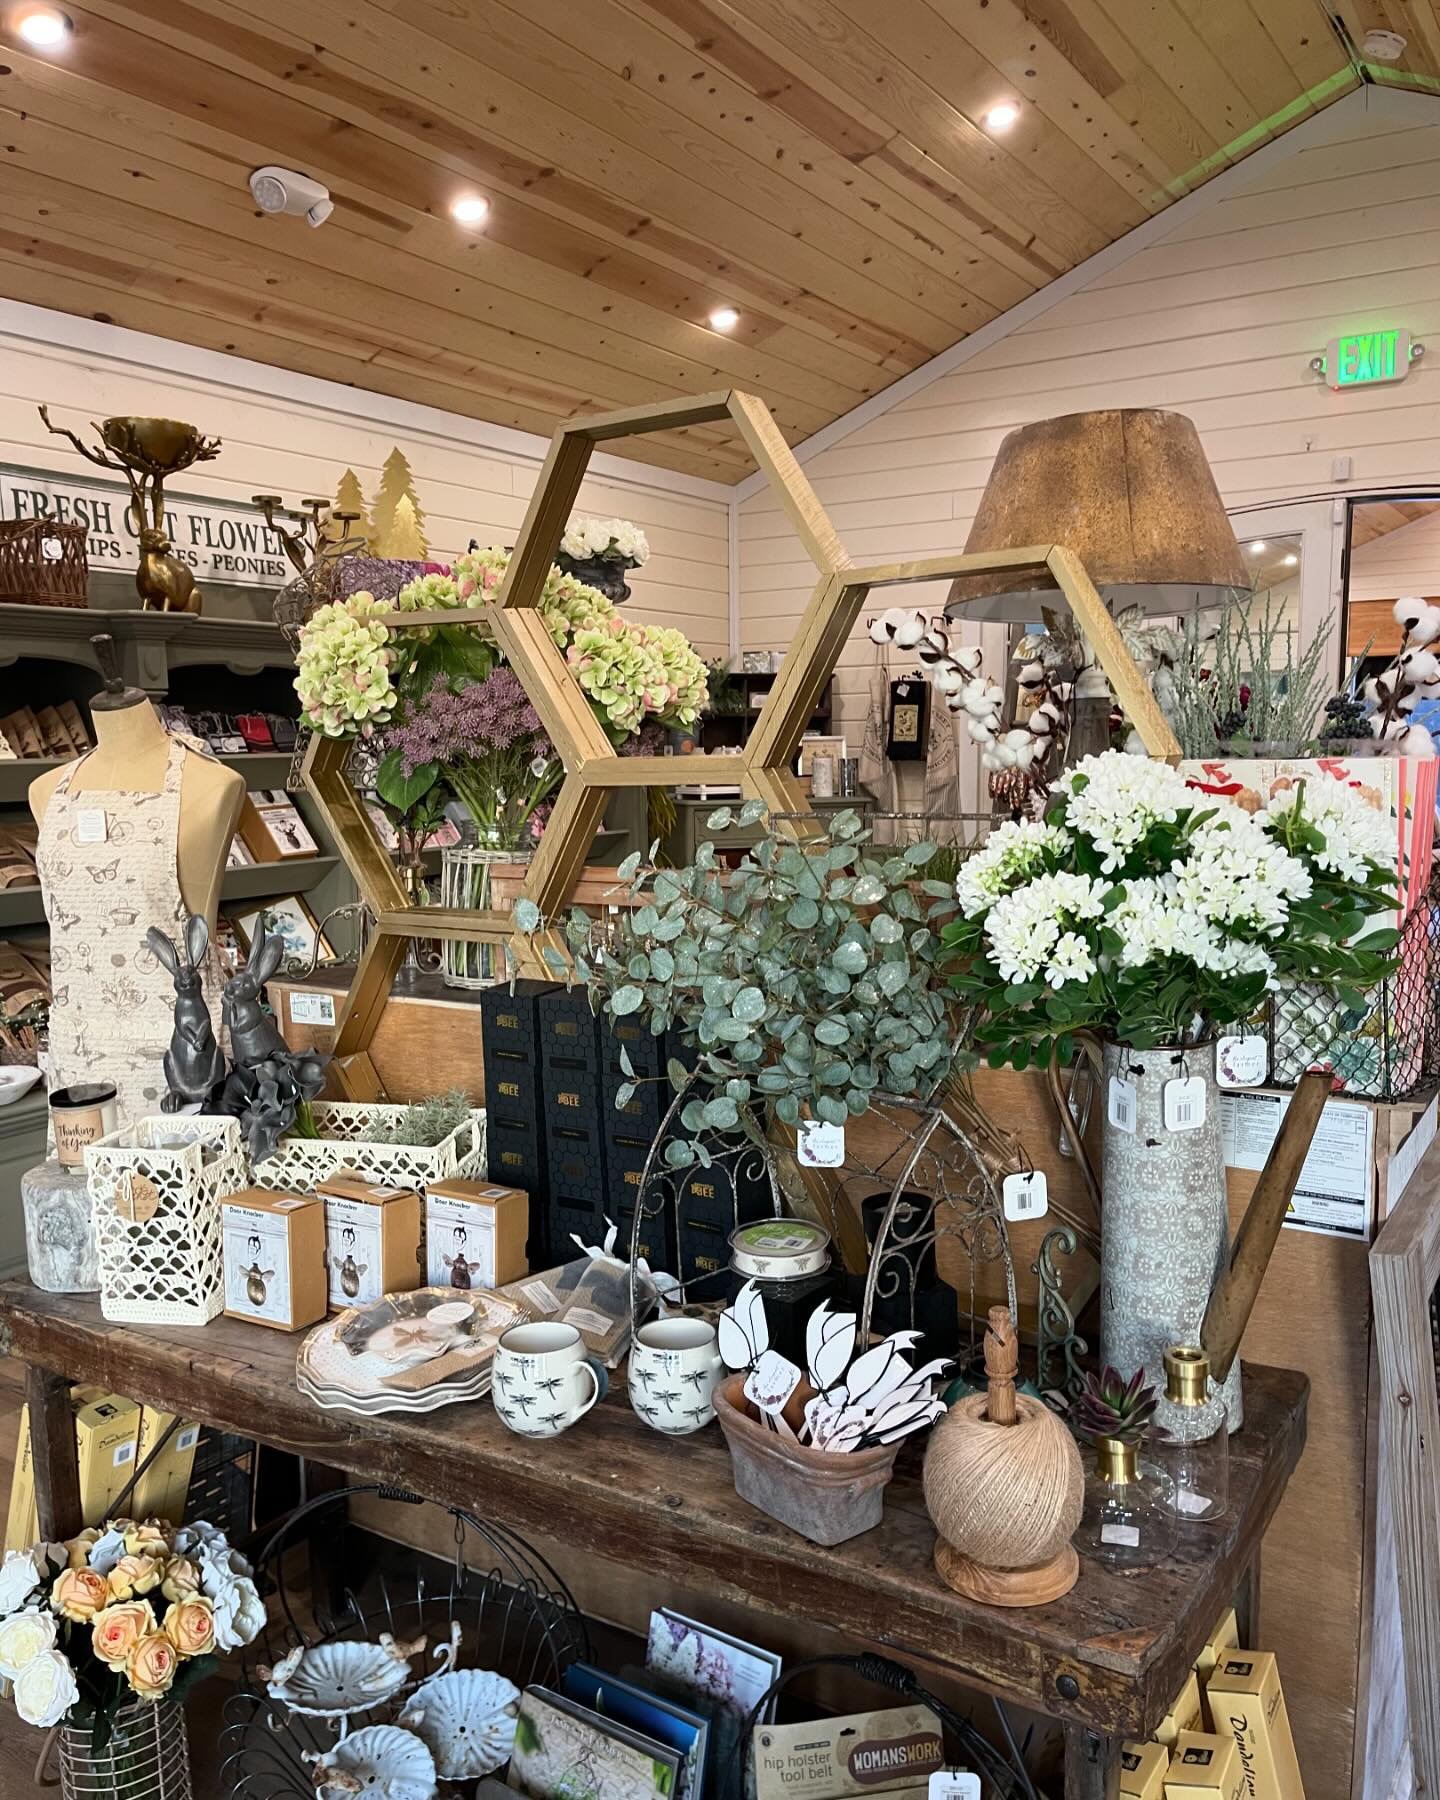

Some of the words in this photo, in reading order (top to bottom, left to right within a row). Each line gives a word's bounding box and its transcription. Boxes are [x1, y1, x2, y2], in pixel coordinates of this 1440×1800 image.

[1338, 330, 1400, 384] EXIT
[10, 488, 114, 534] FRESH
[188, 515, 286, 557] FLOWE
[212, 553, 286, 577] PEONIES
[57, 1123, 95, 1138] Thinking
[764, 1756, 784, 1772] hip
[787, 1752, 832, 1768] holster
[853, 1740, 942, 1770] WOMANSWORK
[781, 1767, 805, 1783] tool
[808, 1764, 833, 1779] belt
